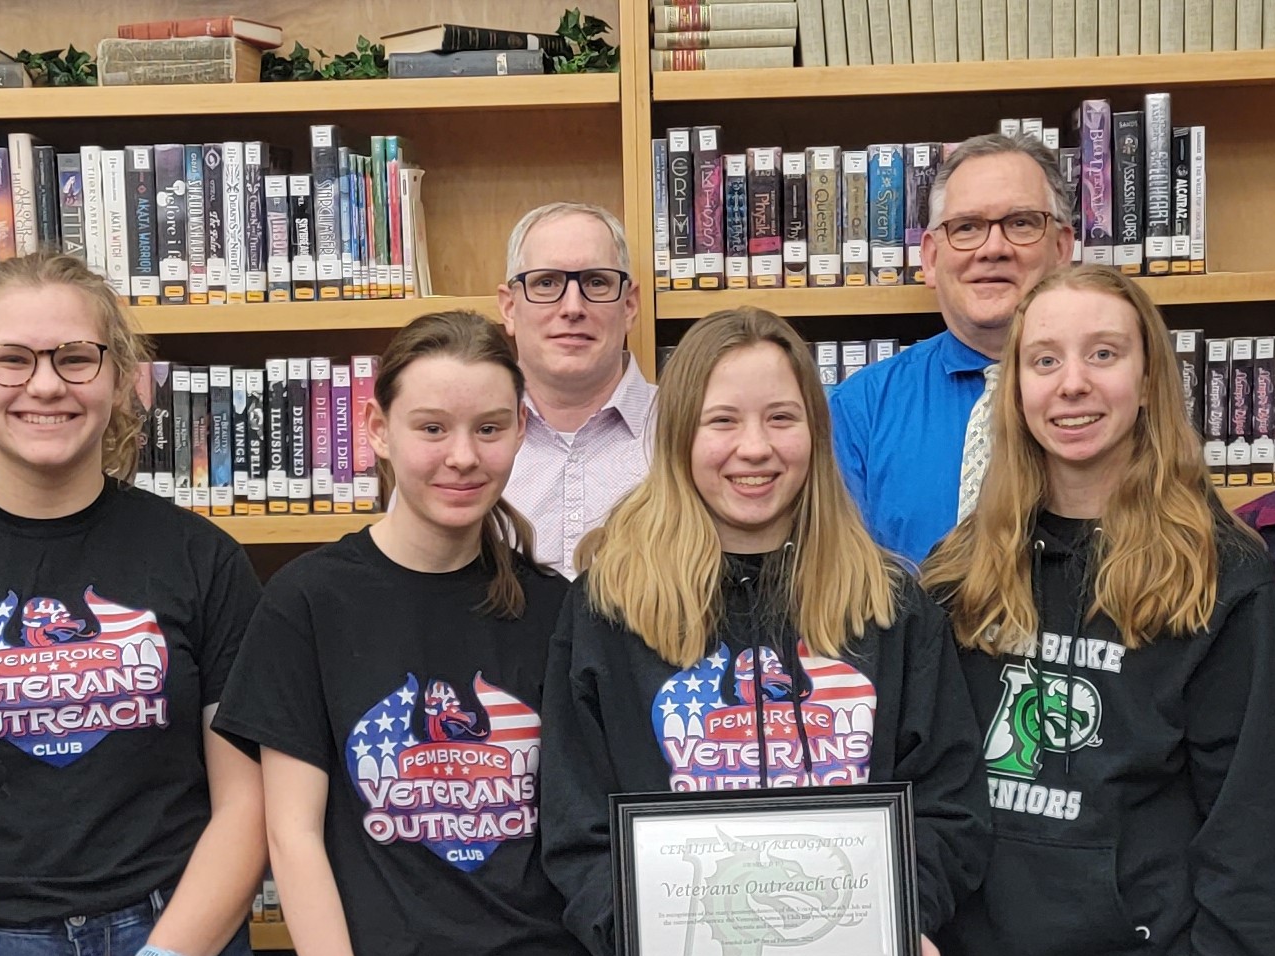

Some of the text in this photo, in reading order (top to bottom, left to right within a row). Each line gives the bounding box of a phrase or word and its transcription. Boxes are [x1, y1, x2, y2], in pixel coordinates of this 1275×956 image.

[754, 193, 770, 236] Physik
[814, 188, 829, 243] Queste
[877, 190, 893, 238] Syren
[1175, 178, 1188, 220] ALCATRAZ
[109, 210, 123, 258] AKATA WITCH
[136, 197, 153, 274] AKATA WARRIOR
[187, 180, 205, 267] SHADOWSHAPER
[1124, 213, 1139, 243] CURSE
[154, 408, 169, 450] Sweetly
[315, 396, 327, 455] DIE FOR
[336, 396, 348, 436] UNTIL
[235, 421, 245, 464] WINGS
[249, 439, 261, 479] SPELL
[270, 408, 282, 473] ILLUSION
[292, 405, 305, 478] DESTINED
[336, 446, 348, 470] DIE
[709, 709, 830, 734] PEMBROKE
[32, 741, 83, 756] CLUB
[402, 748, 508, 773] PEMBROKE
[664, 734, 871, 769] VETERANS
[358, 774, 536, 811] VETERANS
[362, 806, 539, 842] OUTREACH
[446, 849, 485, 862] CLUB
[659, 835, 866, 856] CERTIFICATE OF RECOGNITION
[660, 872, 869, 898] Veterans Outreach Club
